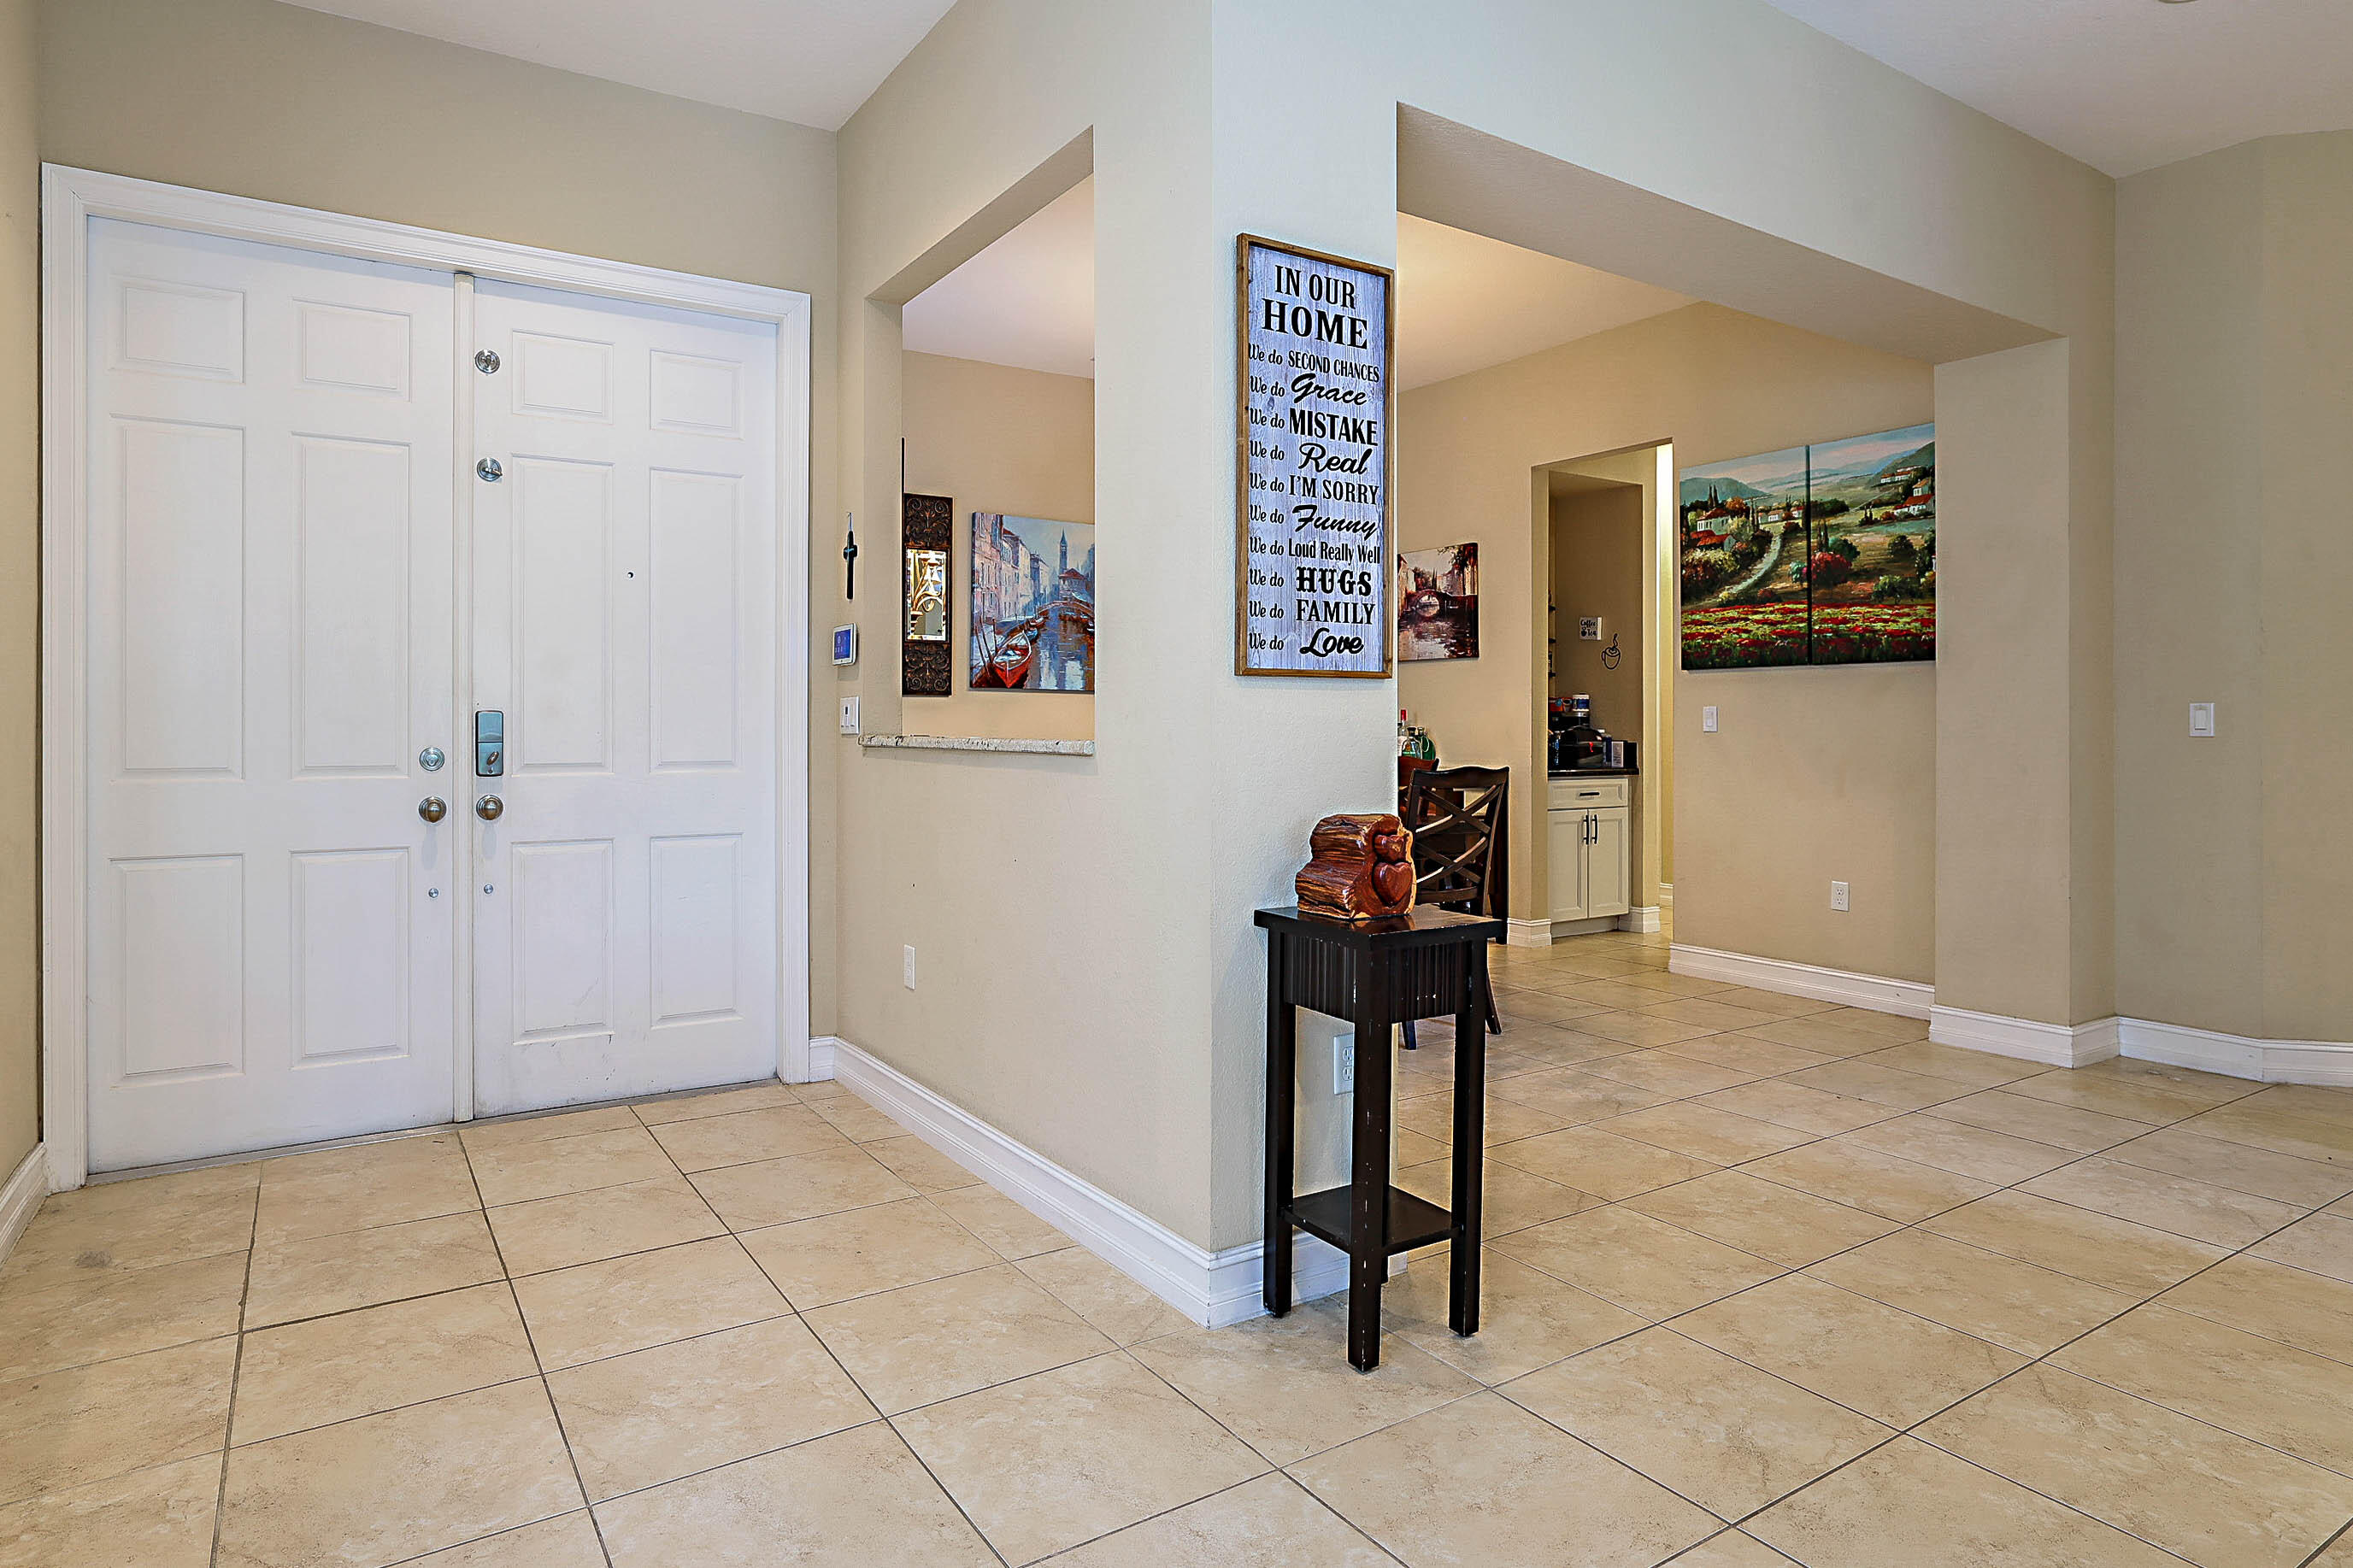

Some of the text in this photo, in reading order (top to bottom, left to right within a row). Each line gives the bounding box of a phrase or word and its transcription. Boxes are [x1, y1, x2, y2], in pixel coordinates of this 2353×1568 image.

[1275, 265, 1356, 309] IN OUR
[1262, 298, 1368, 349] HOME
[1249, 343, 1379, 383] We do SECOND CHANCES
[1250, 373, 1368, 406] We do Grace
[1250, 408, 1378, 446] We do MISTAKE
[1250, 441, 1373, 474] We do Real
[1250, 473, 1267, 490] We
[1270, 476, 1285, 492] do
[1322, 479, 1379, 505] SORRY
[1250, 504, 1377, 541] We do Funny
[1250, 537, 1380, 566] We do Loud Really Well
[1250, 566, 1372, 596] We do HUGS
[1250, 599, 1376, 625] We do FAMILY
[1250, 627, 1364, 657] We do Love
